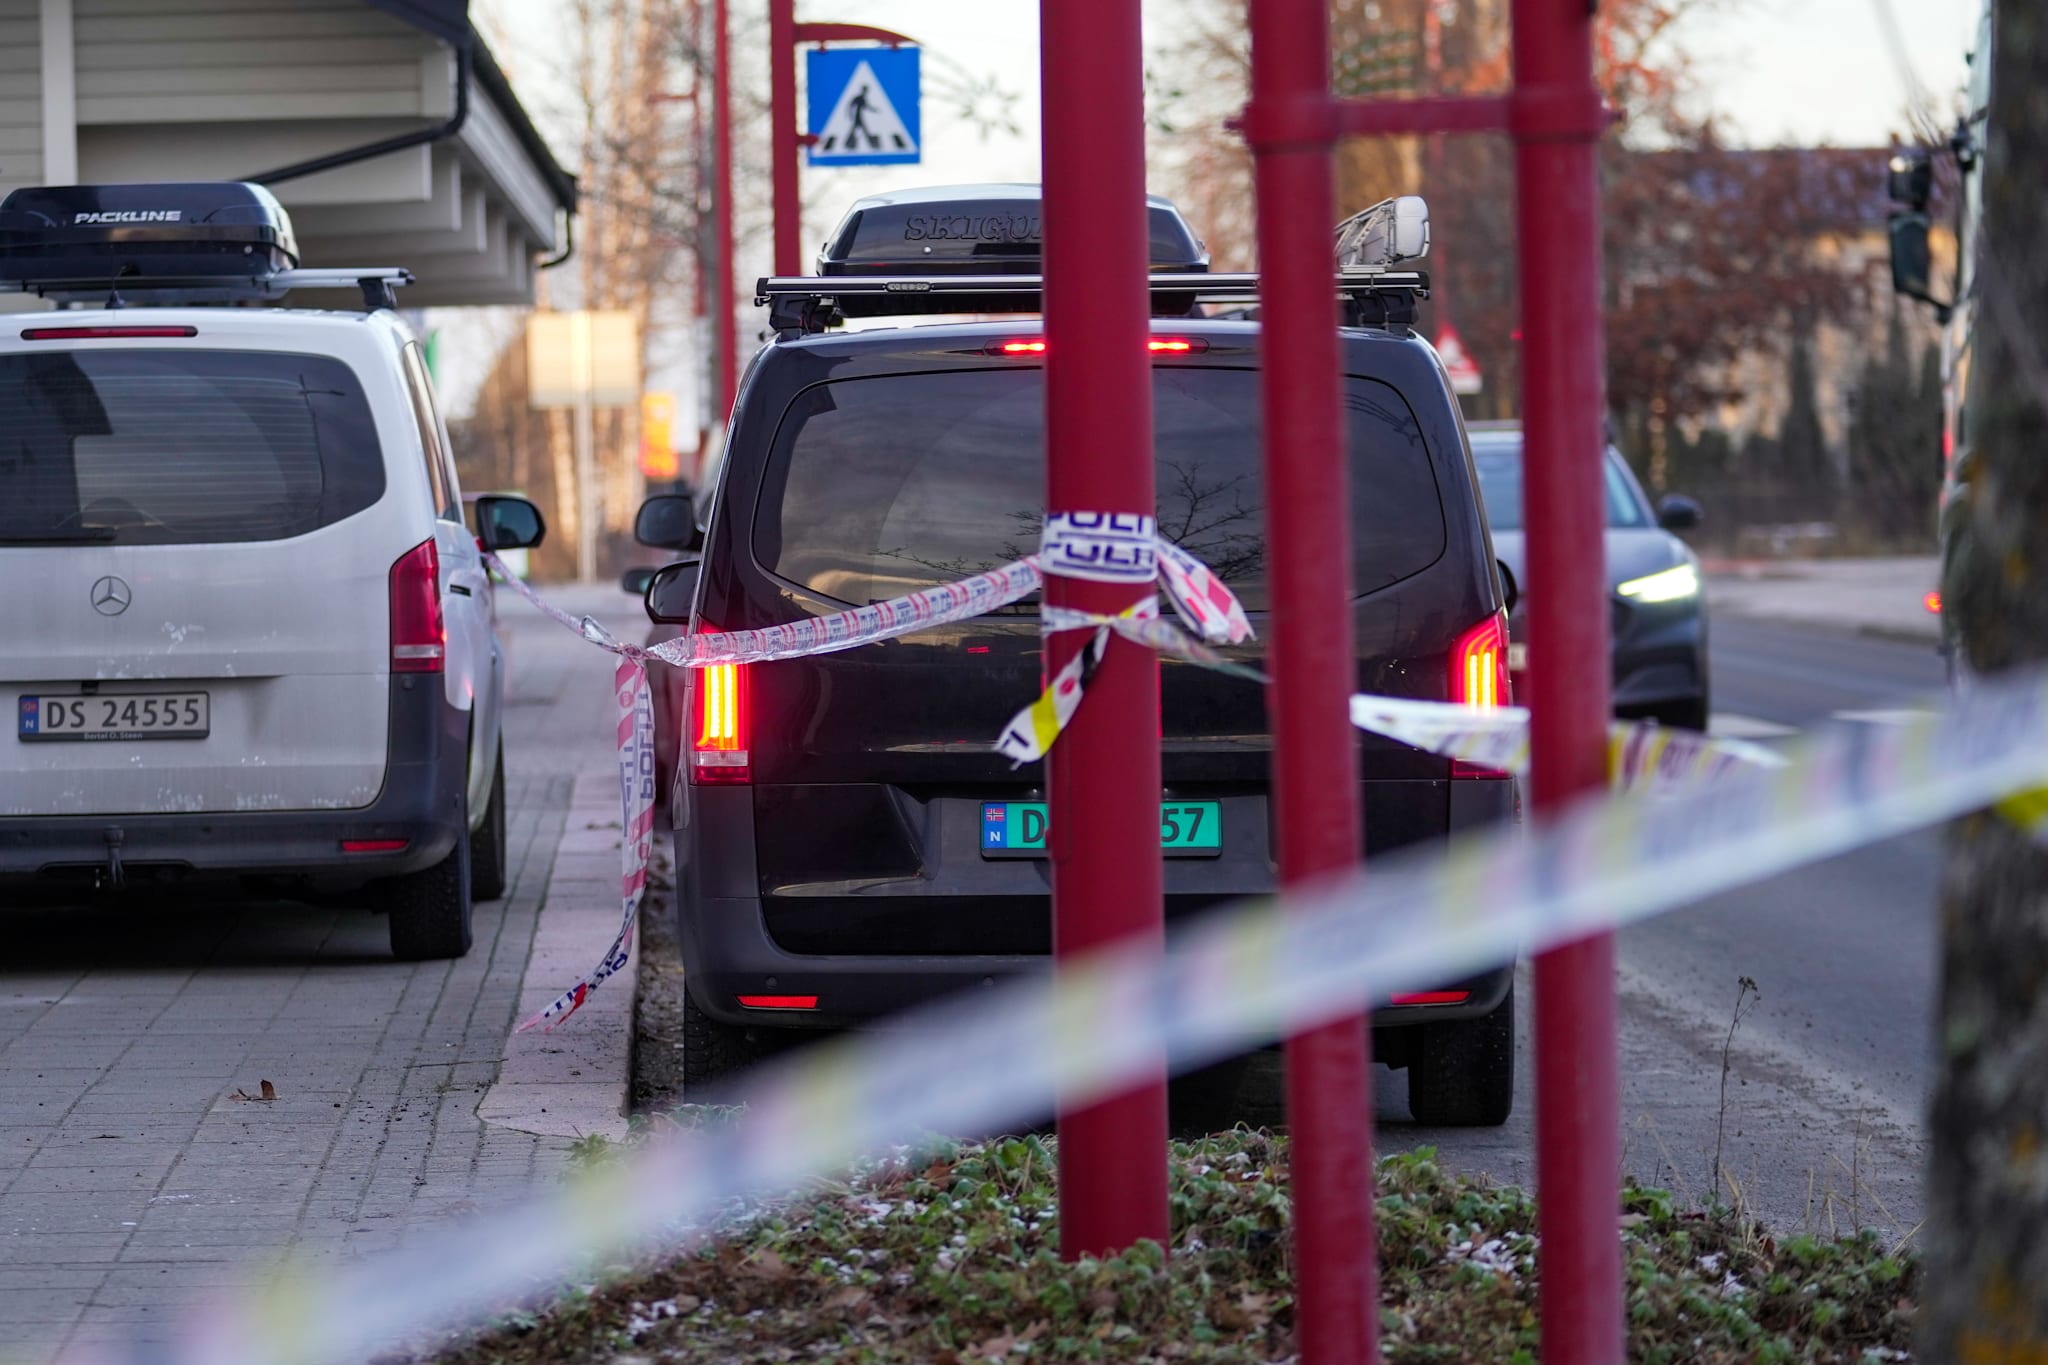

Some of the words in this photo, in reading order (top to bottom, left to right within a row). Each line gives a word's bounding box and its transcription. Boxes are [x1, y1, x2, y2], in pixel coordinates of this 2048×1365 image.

[74, 210, 182, 224] PACKLINE
[905, 214, 1043, 241] SKIGU
[25, 719, 34, 728] N
[47, 701, 86, 729] DS
[102, 699, 200, 727] 24555
[1022, 809, 1046, 844] D
[1161, 808, 1205, 843] 57
[990, 831, 1001, 842] N
